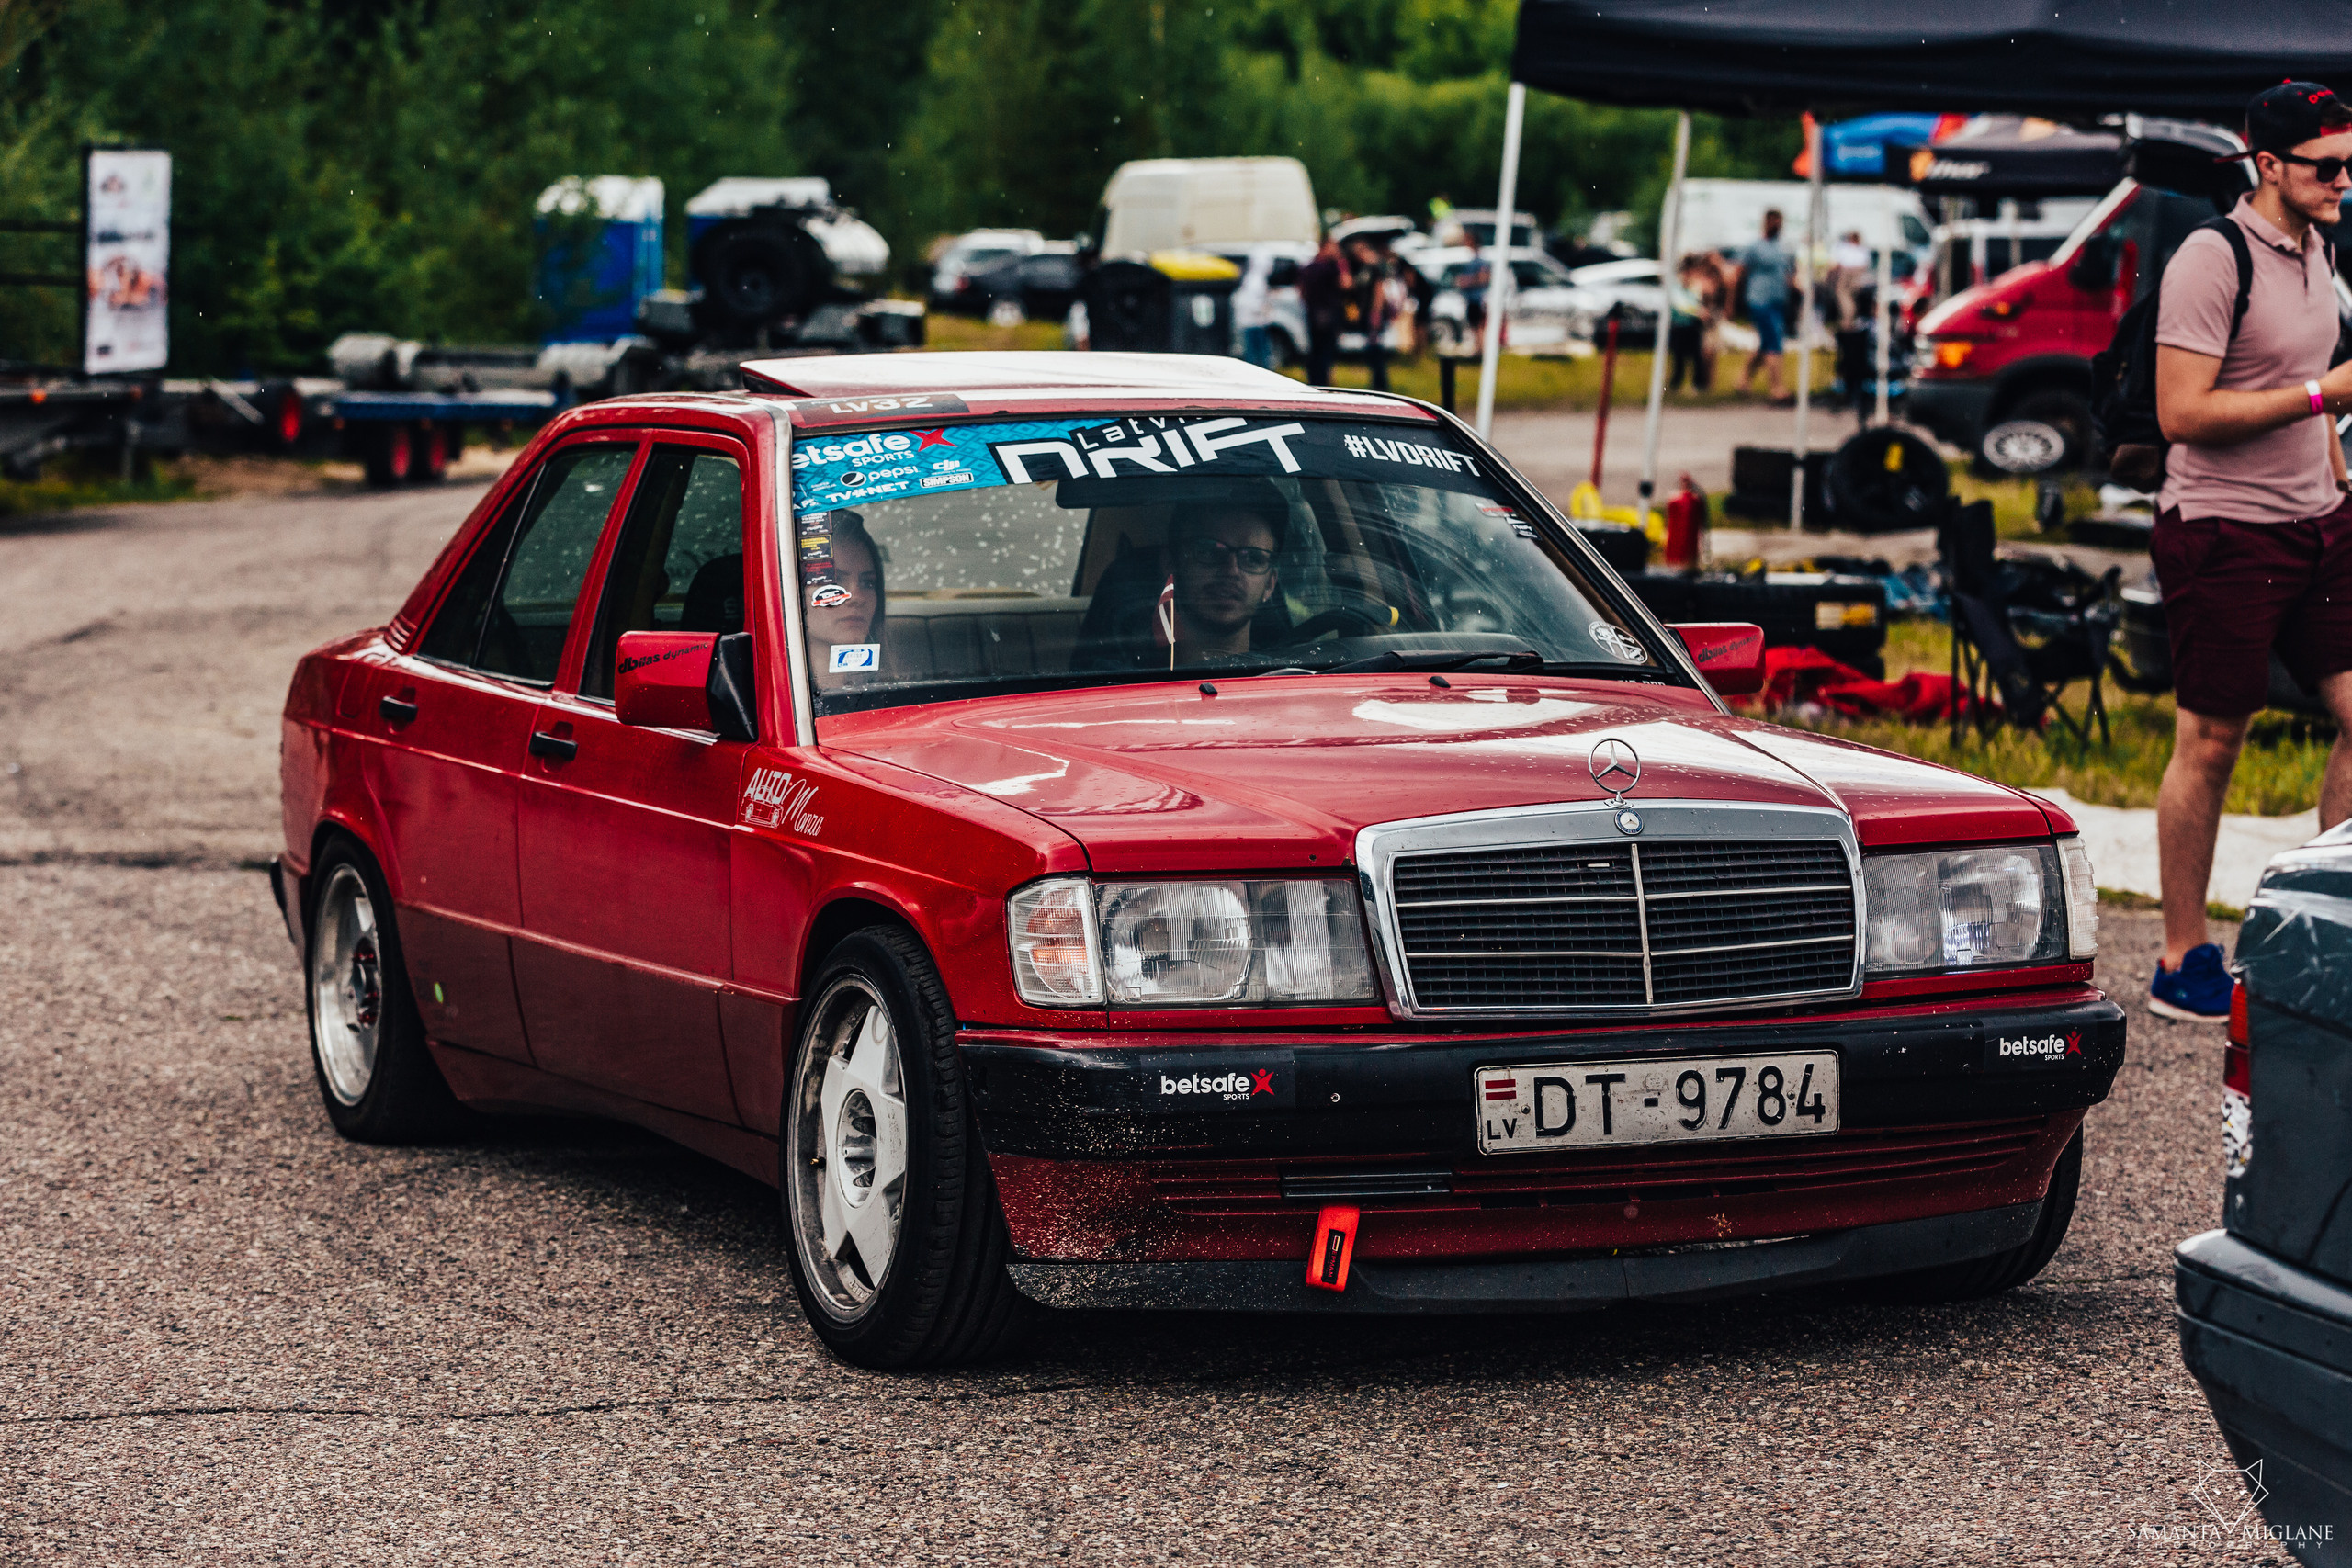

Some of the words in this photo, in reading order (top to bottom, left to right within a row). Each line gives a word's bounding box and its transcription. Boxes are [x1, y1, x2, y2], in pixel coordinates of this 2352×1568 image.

[830, 396, 933, 414] LV32
[1077, 417, 1202, 450] Latv
[793, 434, 910, 470] etsafe
[852, 450, 915, 468] SPORTS
[1344, 434, 1481, 478] #LVDRIFT
[868, 465, 919, 482] pepsi
[922, 473, 970, 488] SIMPSON
[662, 642, 708, 660] dynamic
[743, 767, 793, 805] AUTO
[781, 778, 824, 837] Monza
[1999, 1033, 2065, 1056] betsafe
[2044, 1053, 2064, 1061] SPORTS
[1160, 1072, 1250, 1095] betsafe
[1223, 1092, 1250, 1100] SPORTS
[1533, 1063, 1826, 1139] DT-9784
[1487, 1118, 1518, 1141] LV
[848, 1280, 871, 1299] ORBET
